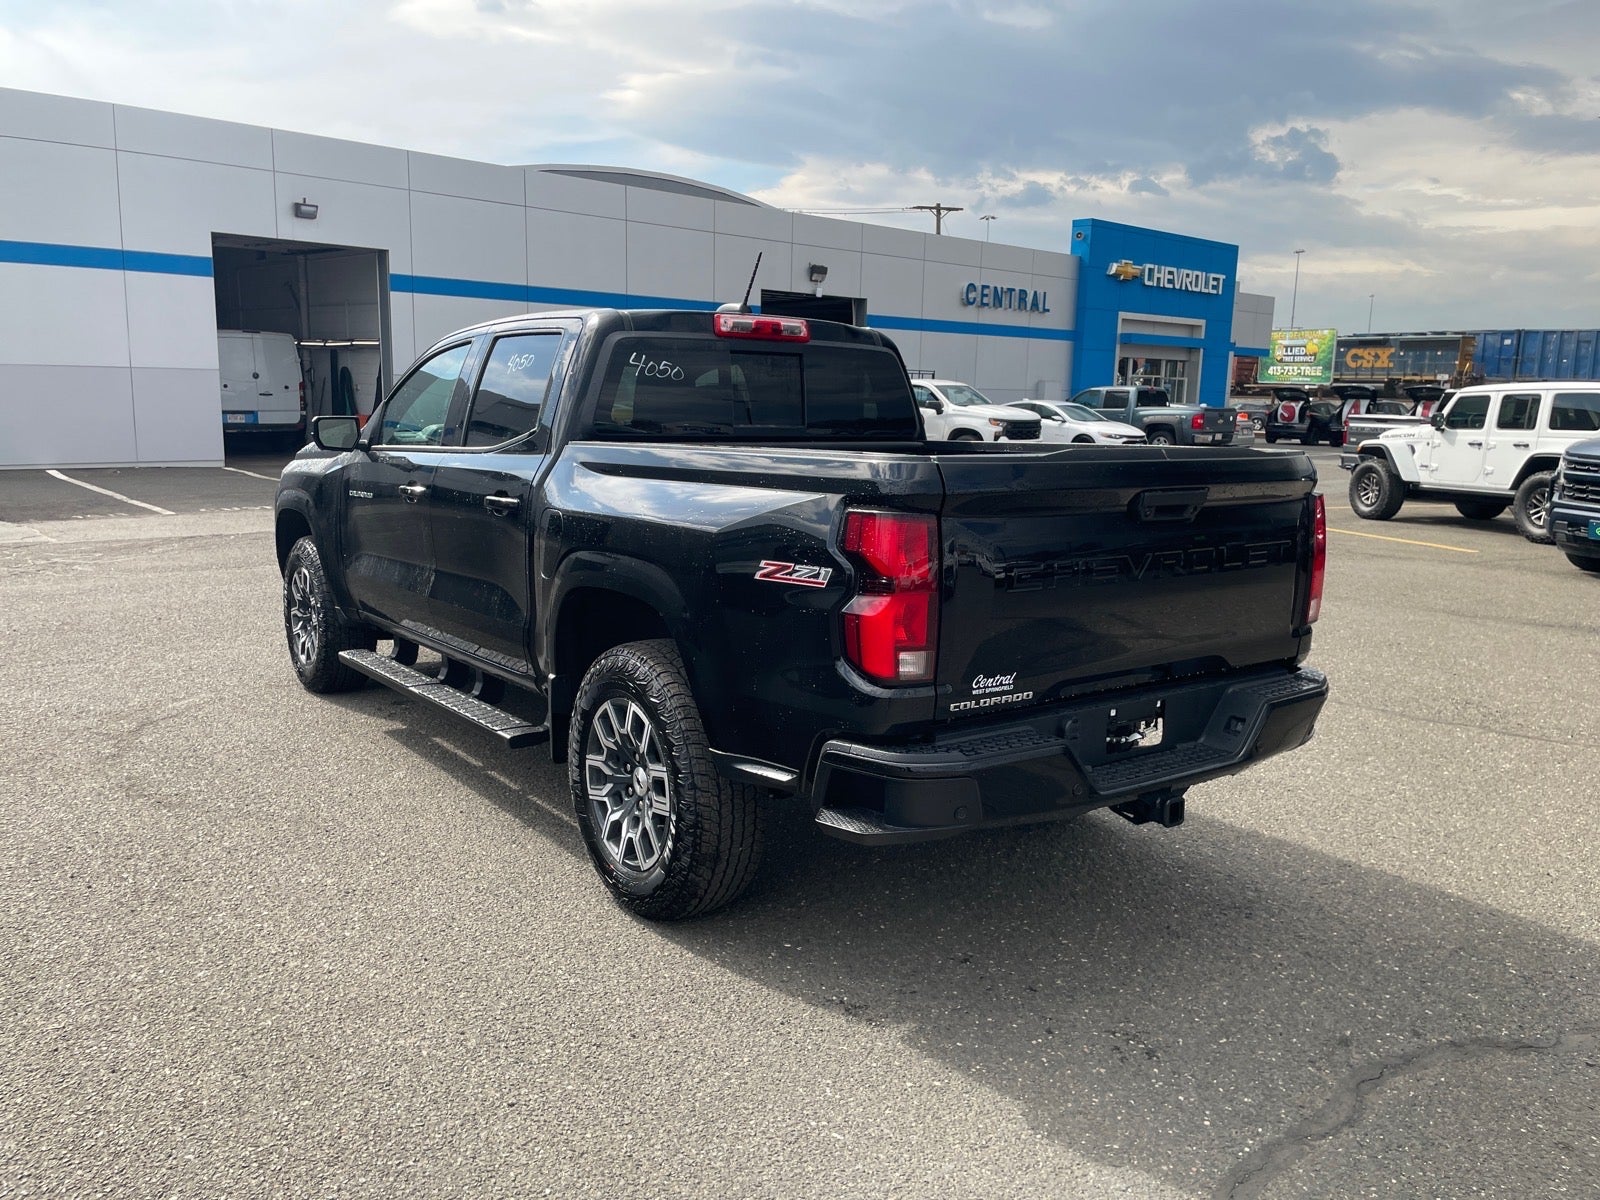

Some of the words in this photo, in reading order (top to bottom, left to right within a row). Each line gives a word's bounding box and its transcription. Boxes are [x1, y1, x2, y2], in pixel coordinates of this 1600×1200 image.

[1143, 263, 1226, 295] CHEVROLET
[963, 282, 1051, 313] CENTRAL
[507, 353, 535, 375] 4050
[629, 352, 685, 381] 4050
[1346, 347, 1395, 368] CSX
[1267, 366, 1323, 376] 413-733-TREE
[754, 560, 833, 588] Z71
[1006, 540, 1292, 593] CHEVROLET
[972, 672, 1017, 689] Central
[985, 684, 1014, 694] SPRINGFIELD
[949, 691, 1033, 712] COLORADO
